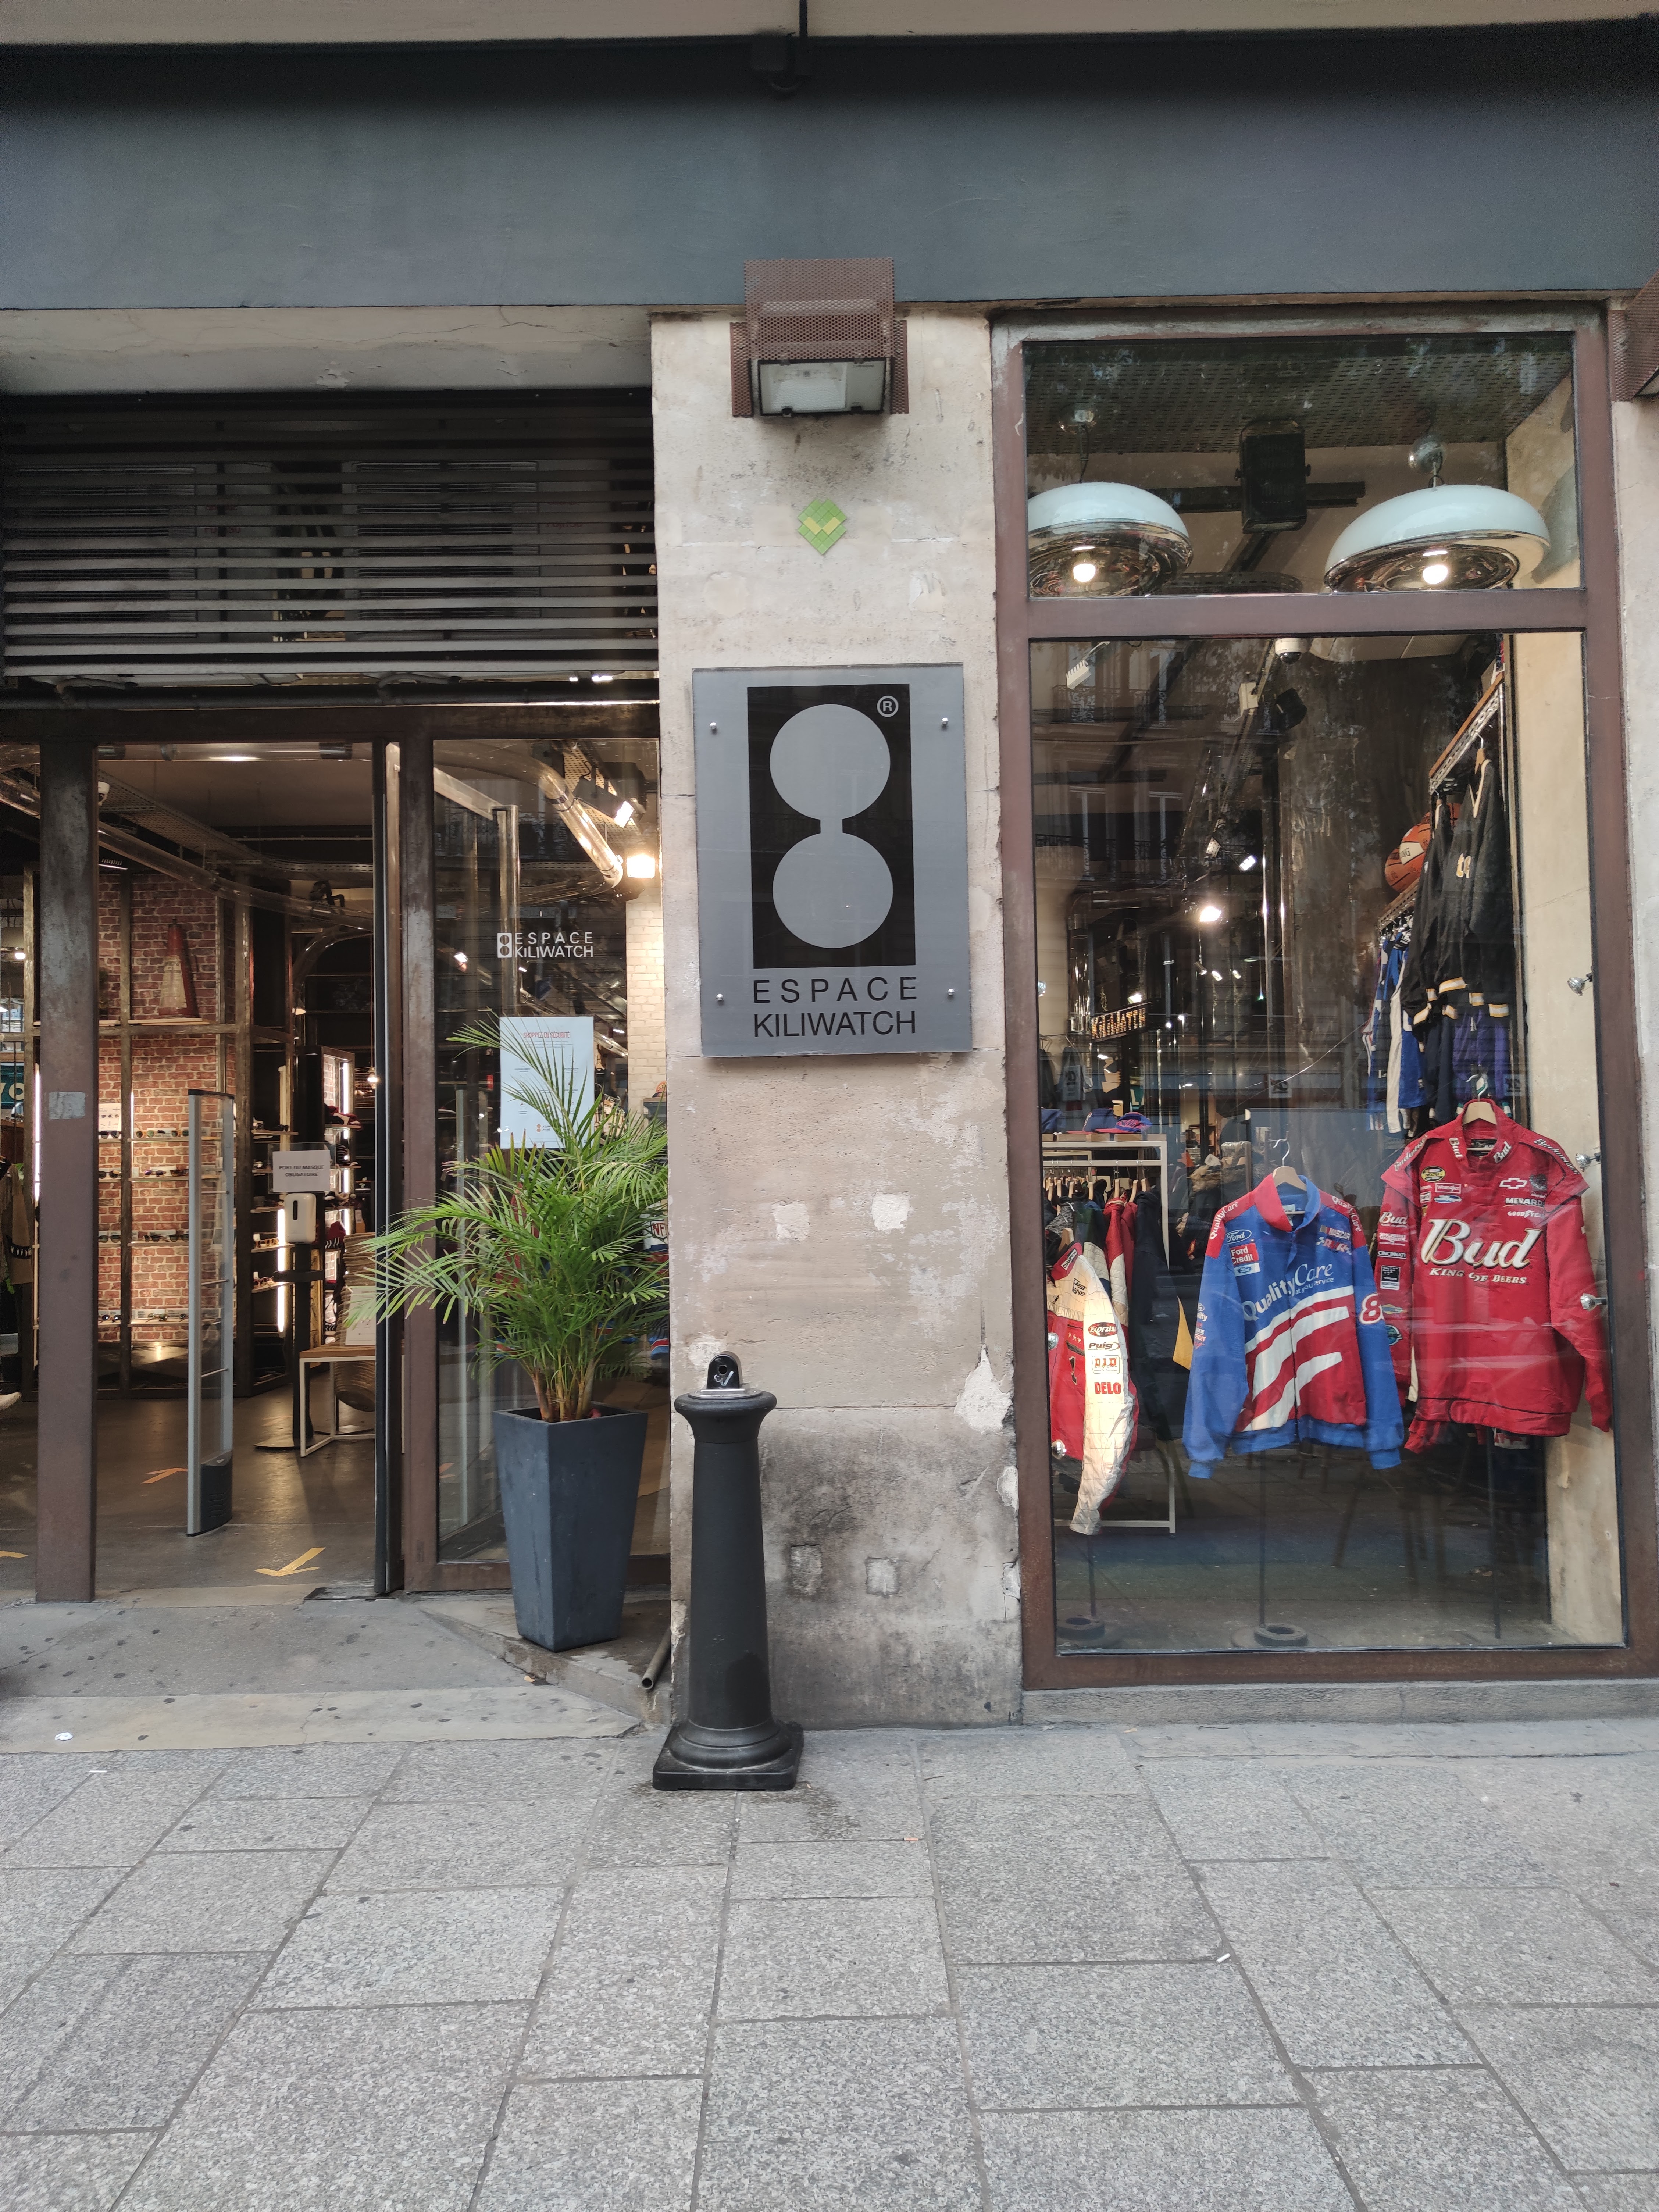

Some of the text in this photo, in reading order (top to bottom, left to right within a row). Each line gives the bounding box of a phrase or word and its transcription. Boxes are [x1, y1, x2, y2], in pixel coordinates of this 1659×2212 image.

[515, 932, 593, 944] ESPACE
[515, 945, 593, 958] KILIWATCH
[753, 976, 917, 1003] ESPACE
[754, 1010, 916, 1038] KILIWATCH
[1493, 1141, 1512, 1163] Bud
[1379, 1211, 1408, 1224] Bud
[652, 1223, 666, 1237] NF
[1227, 1231, 1246, 1242] Ford
[1421, 1218, 1543, 1269] Bud
[1231, 1246, 1249, 1257] Ford
[1232, 1253, 1254, 1264] Credit
[1429, 1267, 1527, 1284] KING OF BEERS
[1094, 1382, 1121, 1394] DELO
